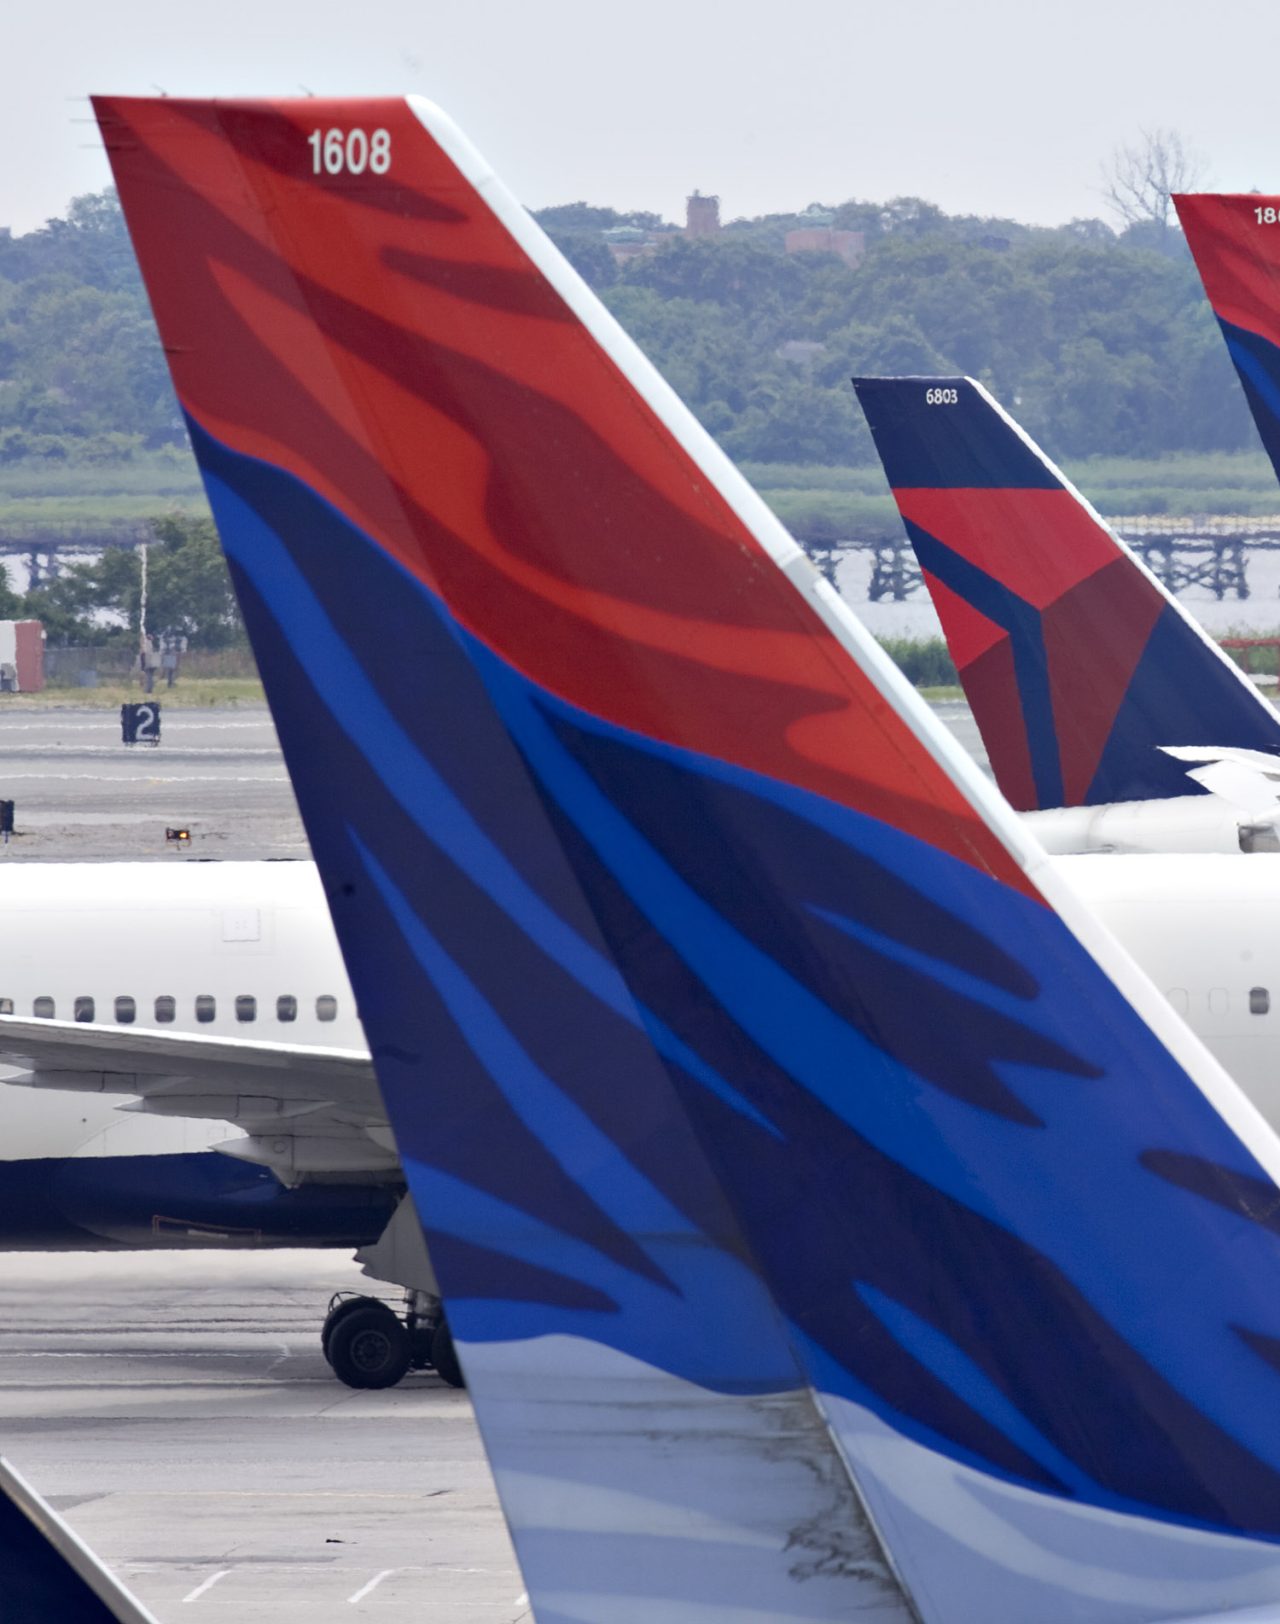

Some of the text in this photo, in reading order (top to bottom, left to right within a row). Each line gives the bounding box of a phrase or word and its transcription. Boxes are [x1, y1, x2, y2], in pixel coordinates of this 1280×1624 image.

[307, 127, 391, 175] 1608
[926, 388, 958, 405] 6803
[136, 705, 155, 740] 2
